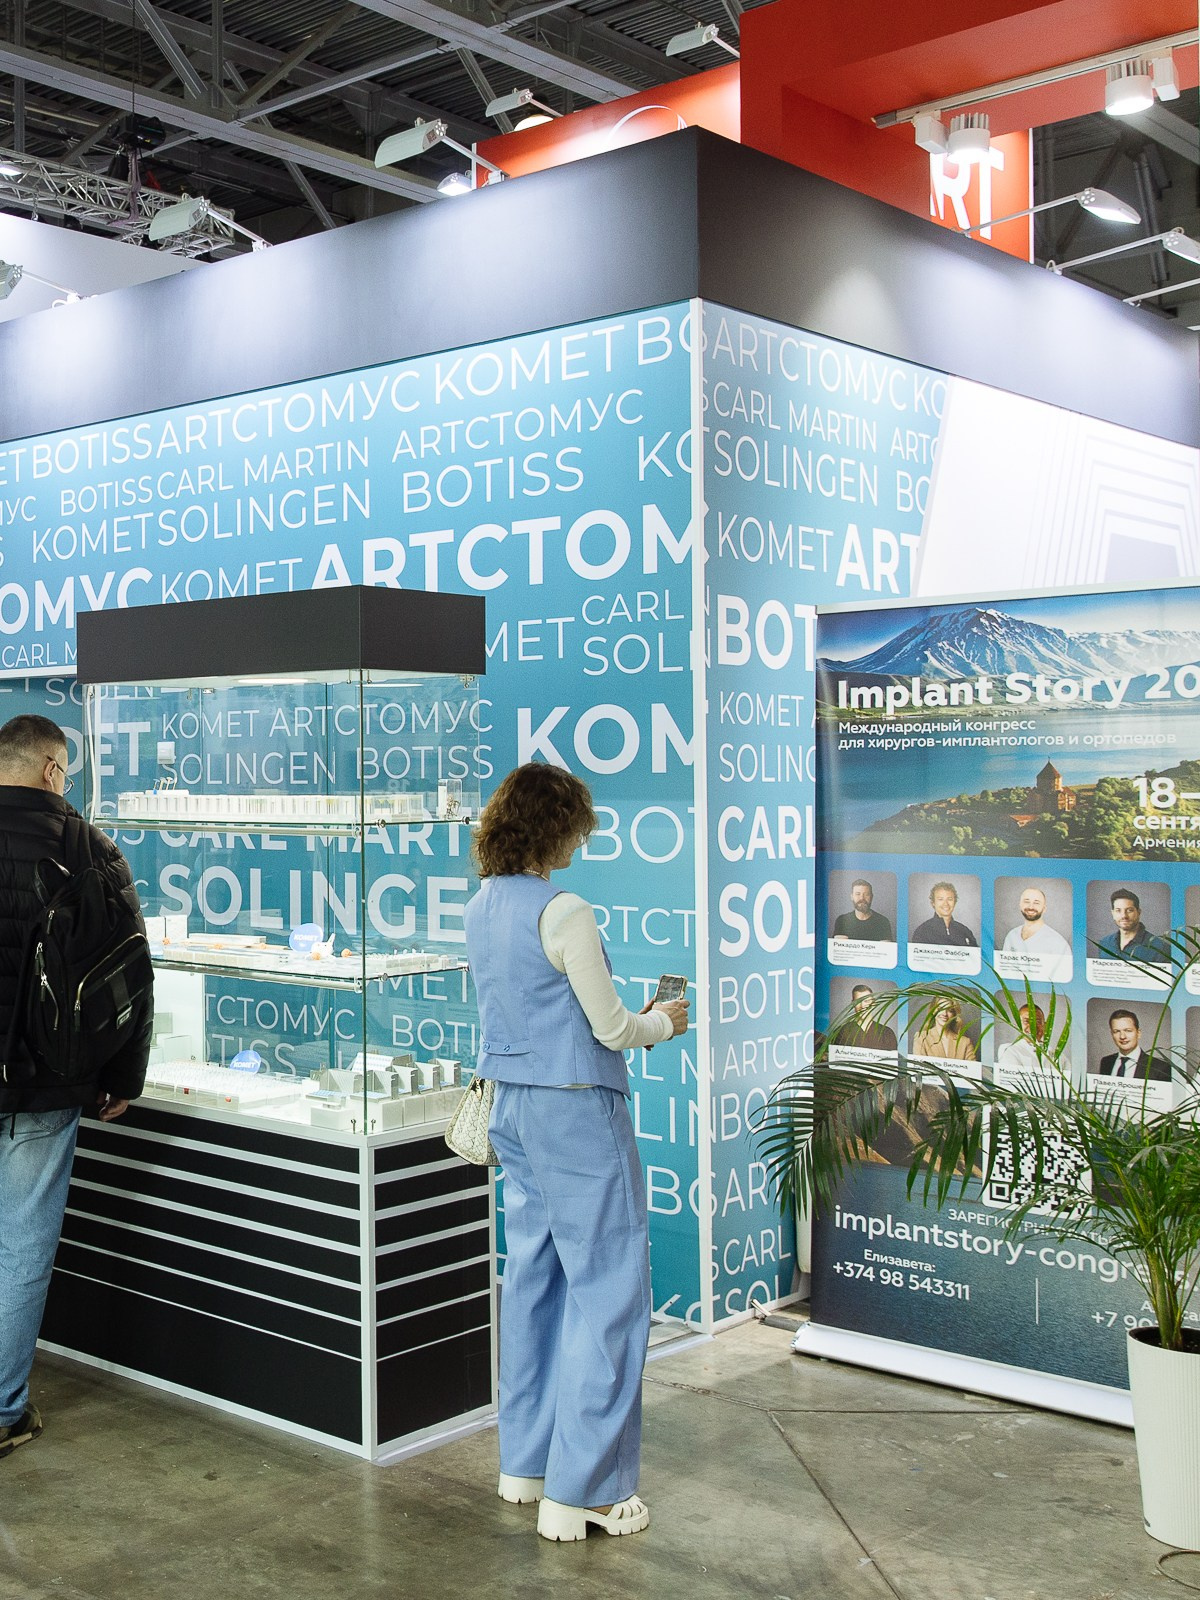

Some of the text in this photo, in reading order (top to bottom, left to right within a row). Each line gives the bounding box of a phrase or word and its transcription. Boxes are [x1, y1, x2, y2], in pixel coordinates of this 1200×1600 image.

[930, 146, 1005, 241] RT
[33, 424, 152, 479] BOTISS
[435, 324, 625, 405] KOMET
[714, 381, 781, 431] CARL
[789, 399, 877, 453] MARTIN
[60, 475, 152, 516] BOTISS
[157, 462, 233, 500] CARL
[244, 436, 369, 487] MARTIN
[714, 429, 878, 507] SOLINGEN
[33, 512, 153, 564] KOMET
[158, 479, 370, 546] SOLINGEN
[402, 447, 584, 514] BOTISS
[718, 511, 834, 574] KOMET
[581, 589, 685, 626] CARL
[1, 643, 57, 668] CARL
[720, 691, 804, 728] KOMET
[837, 676, 993, 716] Implant
[1005, 672, 1132, 709] Story
[162, 710, 259, 740] KOMET
[838, 719, 1036, 735] Международный конгресс
[838, 733, 1177, 751] для хирургов-имплантологов и ортопедов
[161, 744, 494, 785] SOLINGEN BOTISS
[833, 941, 861, 949] Рикардо
[913, 947, 943, 956] Джакомо
[1092, 960, 1123, 968] Марсело
[1117, 1082, 1156, 1091] Ярошеич
[723, 1225, 791, 1275] CARL
[864, 1249, 936, 1272] Елизавета:
[833, 1261, 970, 1300] +374 98 543311
[1091, 1310, 1118, 1328] +7
